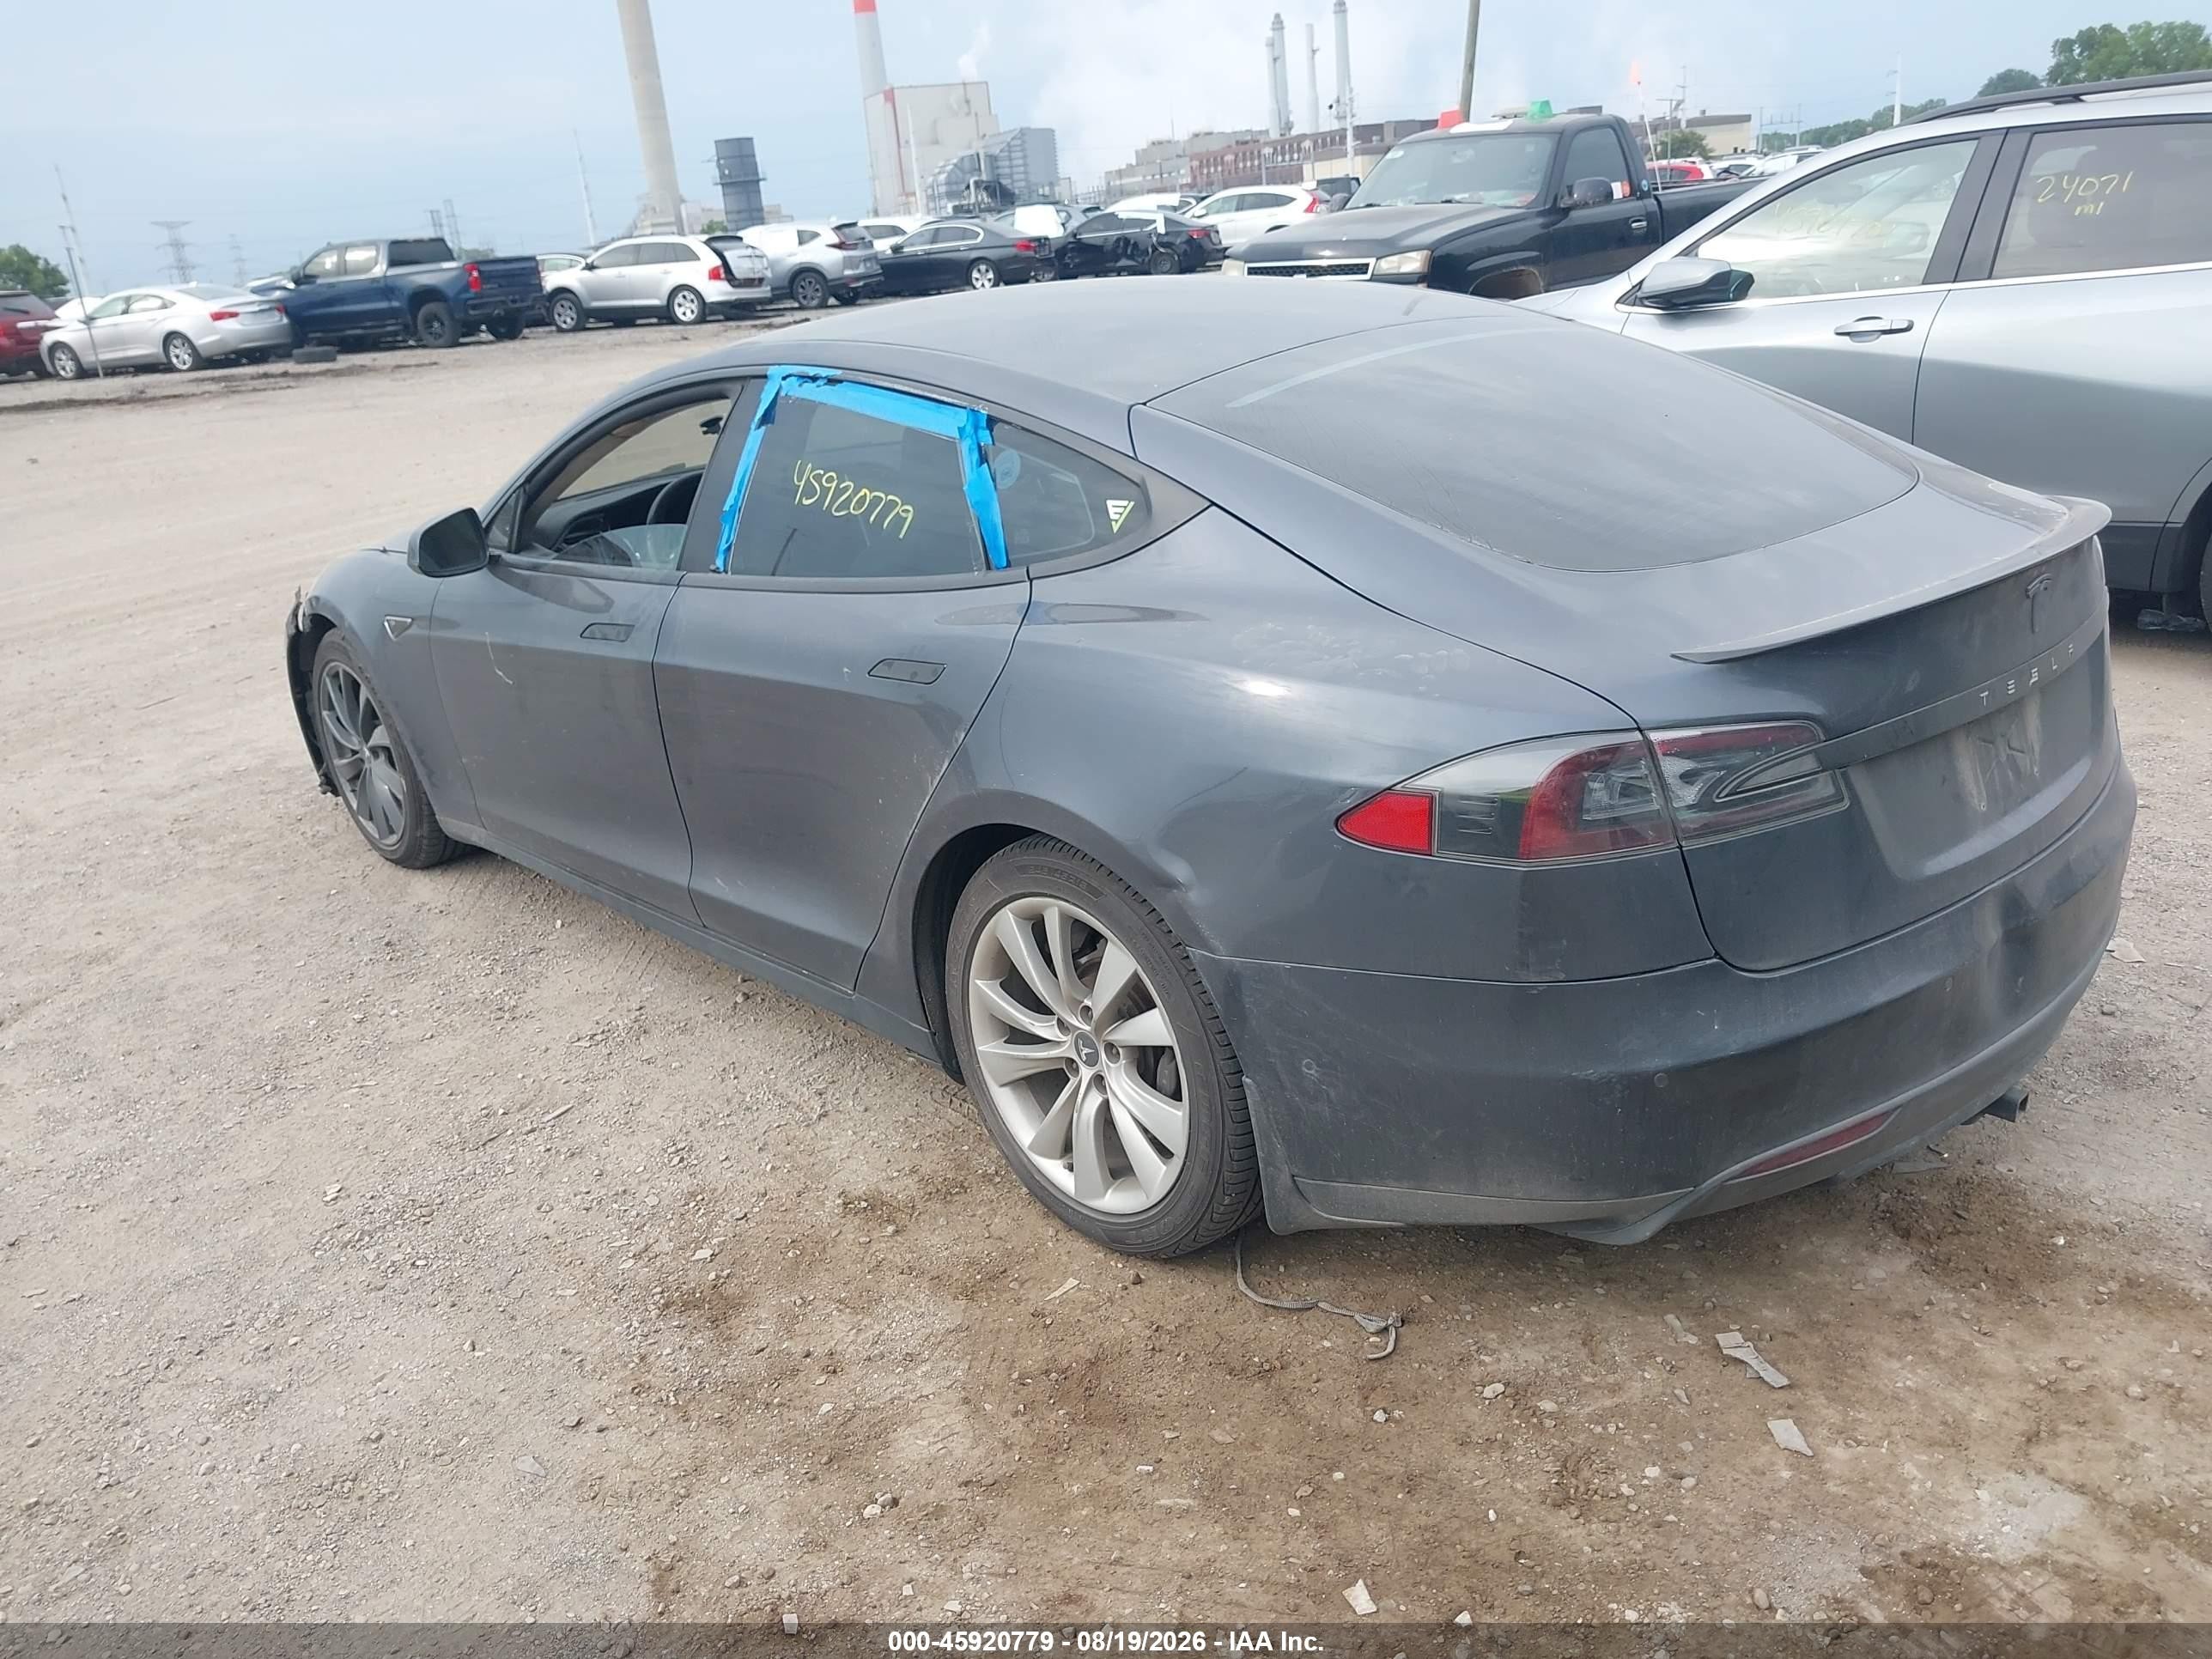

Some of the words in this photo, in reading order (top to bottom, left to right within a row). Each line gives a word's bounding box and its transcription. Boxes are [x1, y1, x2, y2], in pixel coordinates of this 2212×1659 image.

[2036, 169, 2134, 204] 24071
[793, 459, 914, 538] 45920779
[1979, 643, 2074, 706] TESLA
